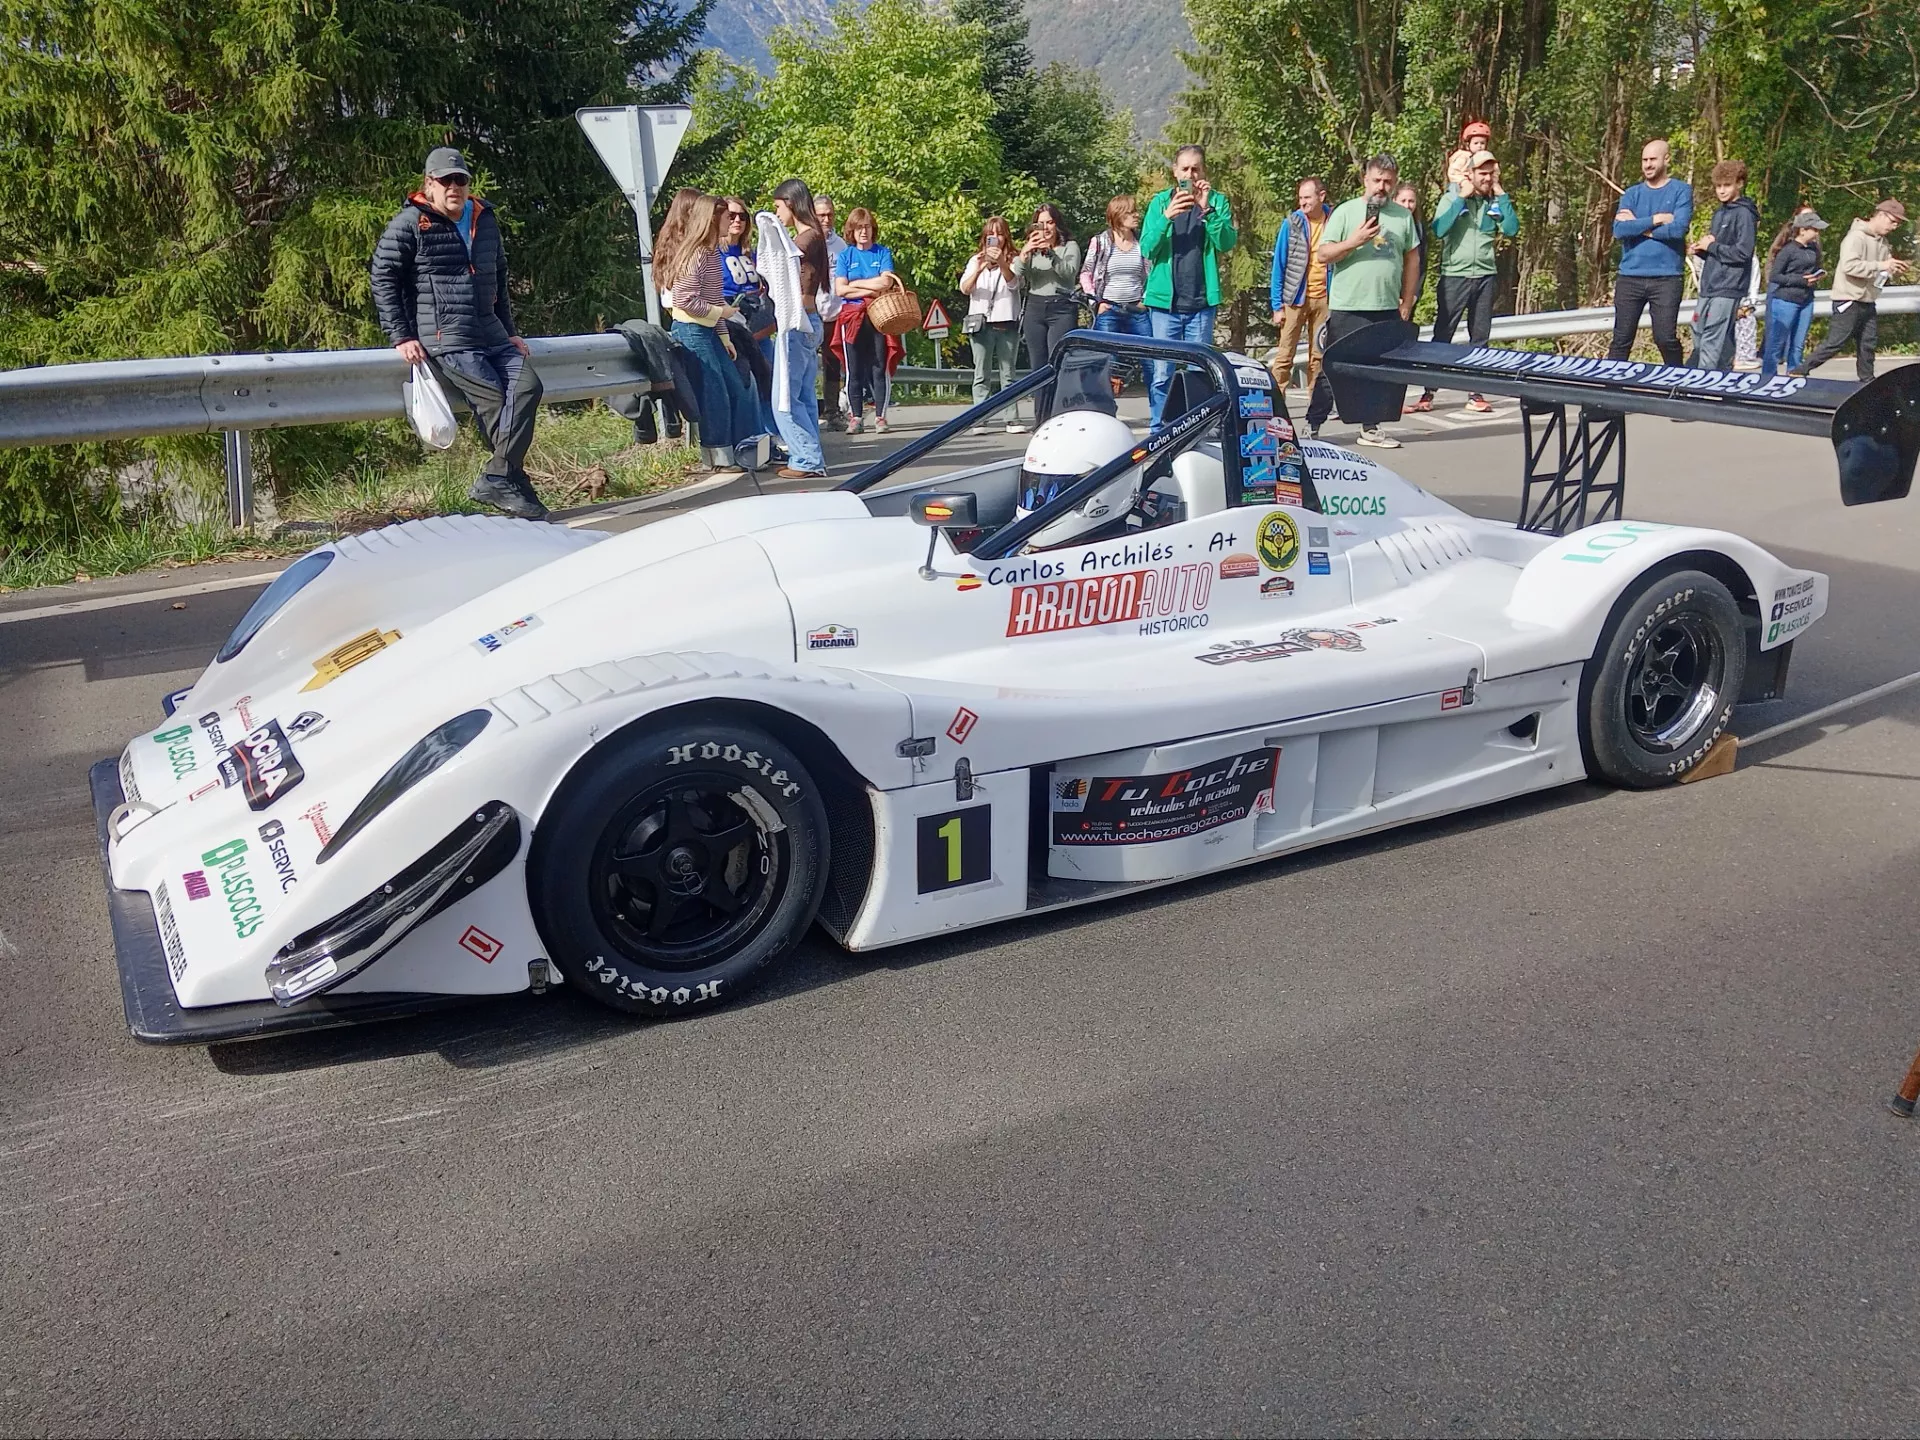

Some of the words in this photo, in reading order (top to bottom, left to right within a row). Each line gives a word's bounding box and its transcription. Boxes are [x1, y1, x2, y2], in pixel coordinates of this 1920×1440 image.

[1638, 365, 1806, 398] VERDES.ES
[1148, 434, 1170, 452] Carlos
[1309, 468, 1368, 482] ERVICAS
[987, 559, 1065, 586] Carlos
[1080, 541, 1174, 572] Archilés
[1208, 532, 1237, 552] A+
[1222, 562, 1259, 570] VERIFICADO
[1139, 613, 1209, 637] HISTÓRICO
[1624, 588, 1694, 663] Hoosier
[809, 638, 855, 649] ZUCAINA
[1202, 643, 1298, 663] LOCURA
[665, 741, 801, 799] Hoosier
[1100, 779, 1150, 801] Tu
[1159, 756, 1270, 798] Coche
[1188, 790, 1202, 807] de
[1060, 804, 1246, 842] www.tucochezaragoza.com
[938, 817, 962, 882] 1
[585, 955, 724, 1005] Hoosier
